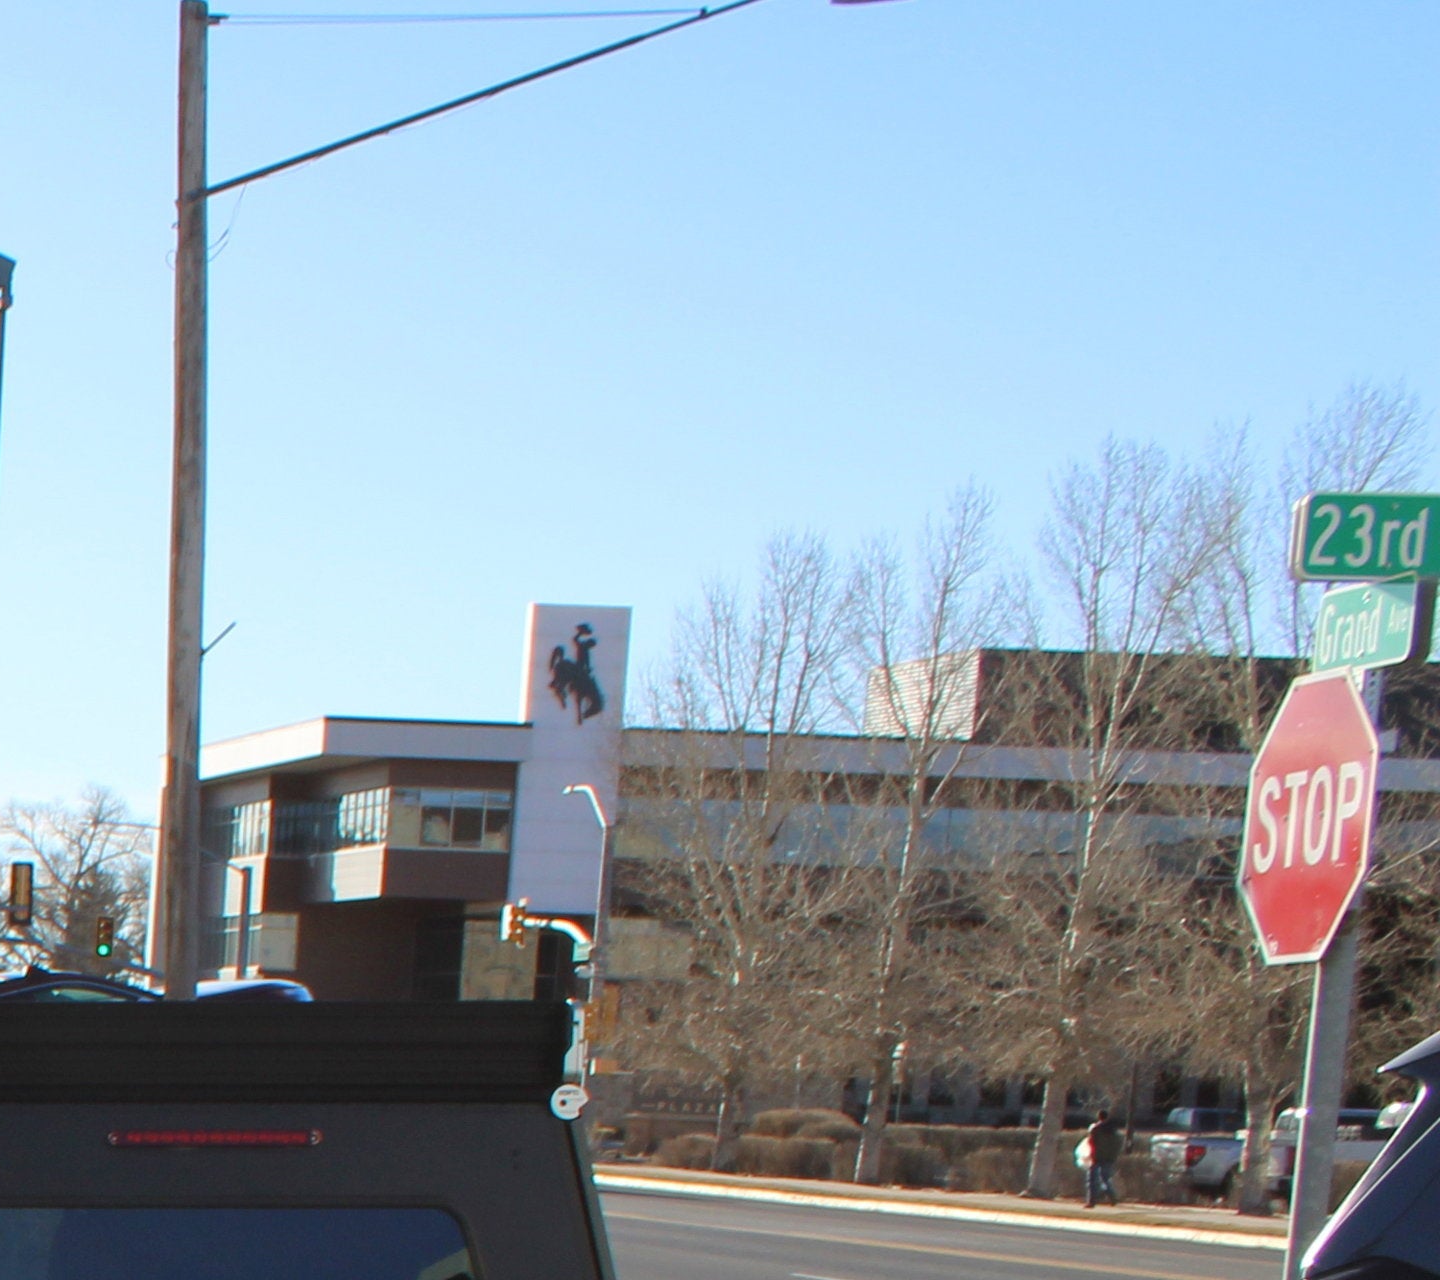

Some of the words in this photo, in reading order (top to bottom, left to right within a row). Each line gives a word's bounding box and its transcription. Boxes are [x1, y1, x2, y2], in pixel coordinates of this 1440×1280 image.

[1308, 503, 1429, 568] 23rd
[1320, 593, 1384, 665] Grand
[1386, 603, 1409, 634] Ave
[1253, 761, 1365, 874] STOP
